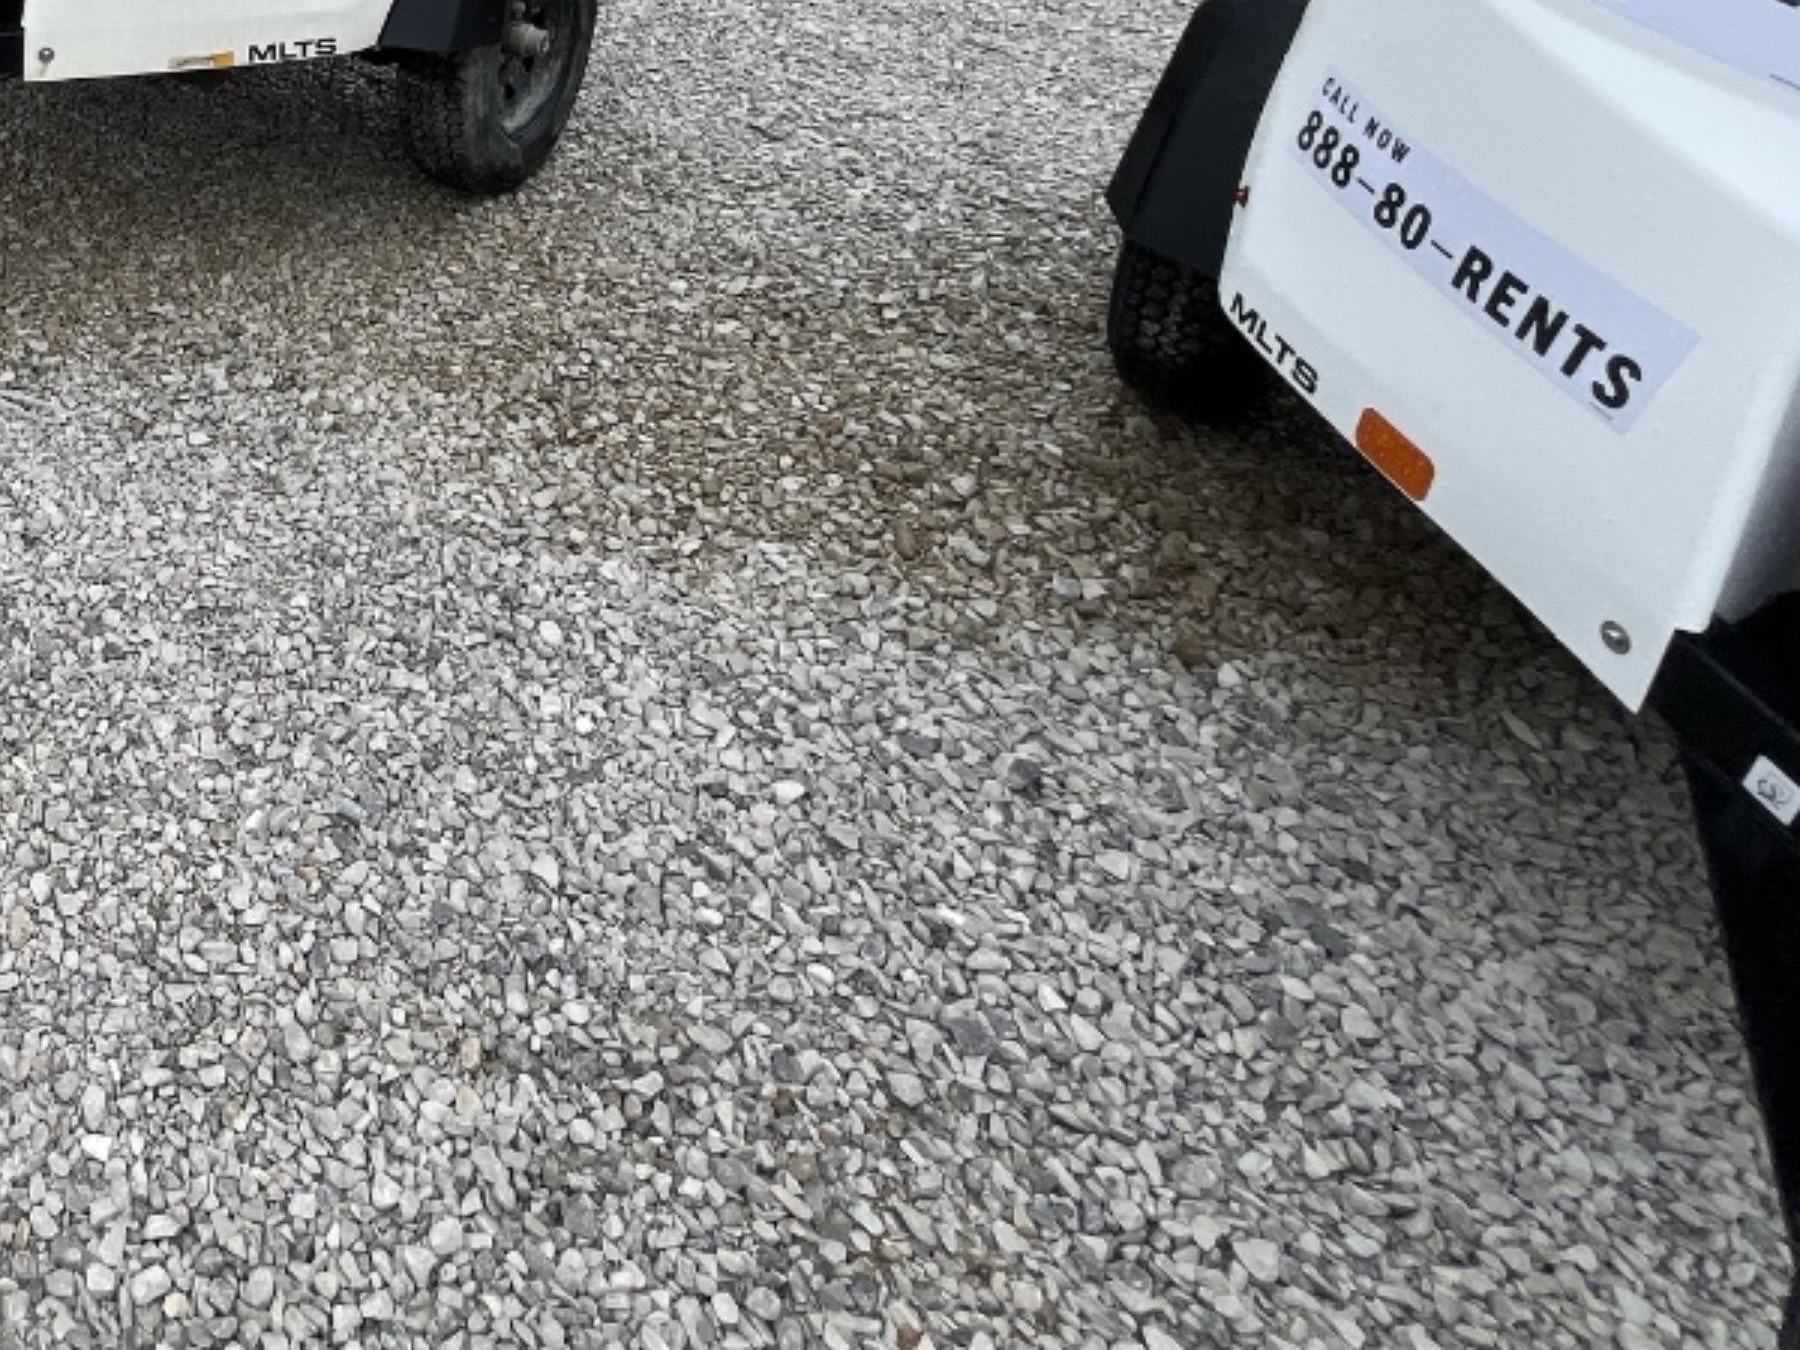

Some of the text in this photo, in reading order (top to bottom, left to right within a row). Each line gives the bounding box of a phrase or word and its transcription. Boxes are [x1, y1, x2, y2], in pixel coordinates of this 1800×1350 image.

[248, 38, 337, 61] MLTS
[1321, 76, 1412, 164] CALL NOW
[1297, 109, 1643, 410] 888-80-RENTS
[1229, 292, 1320, 396] MLTS
